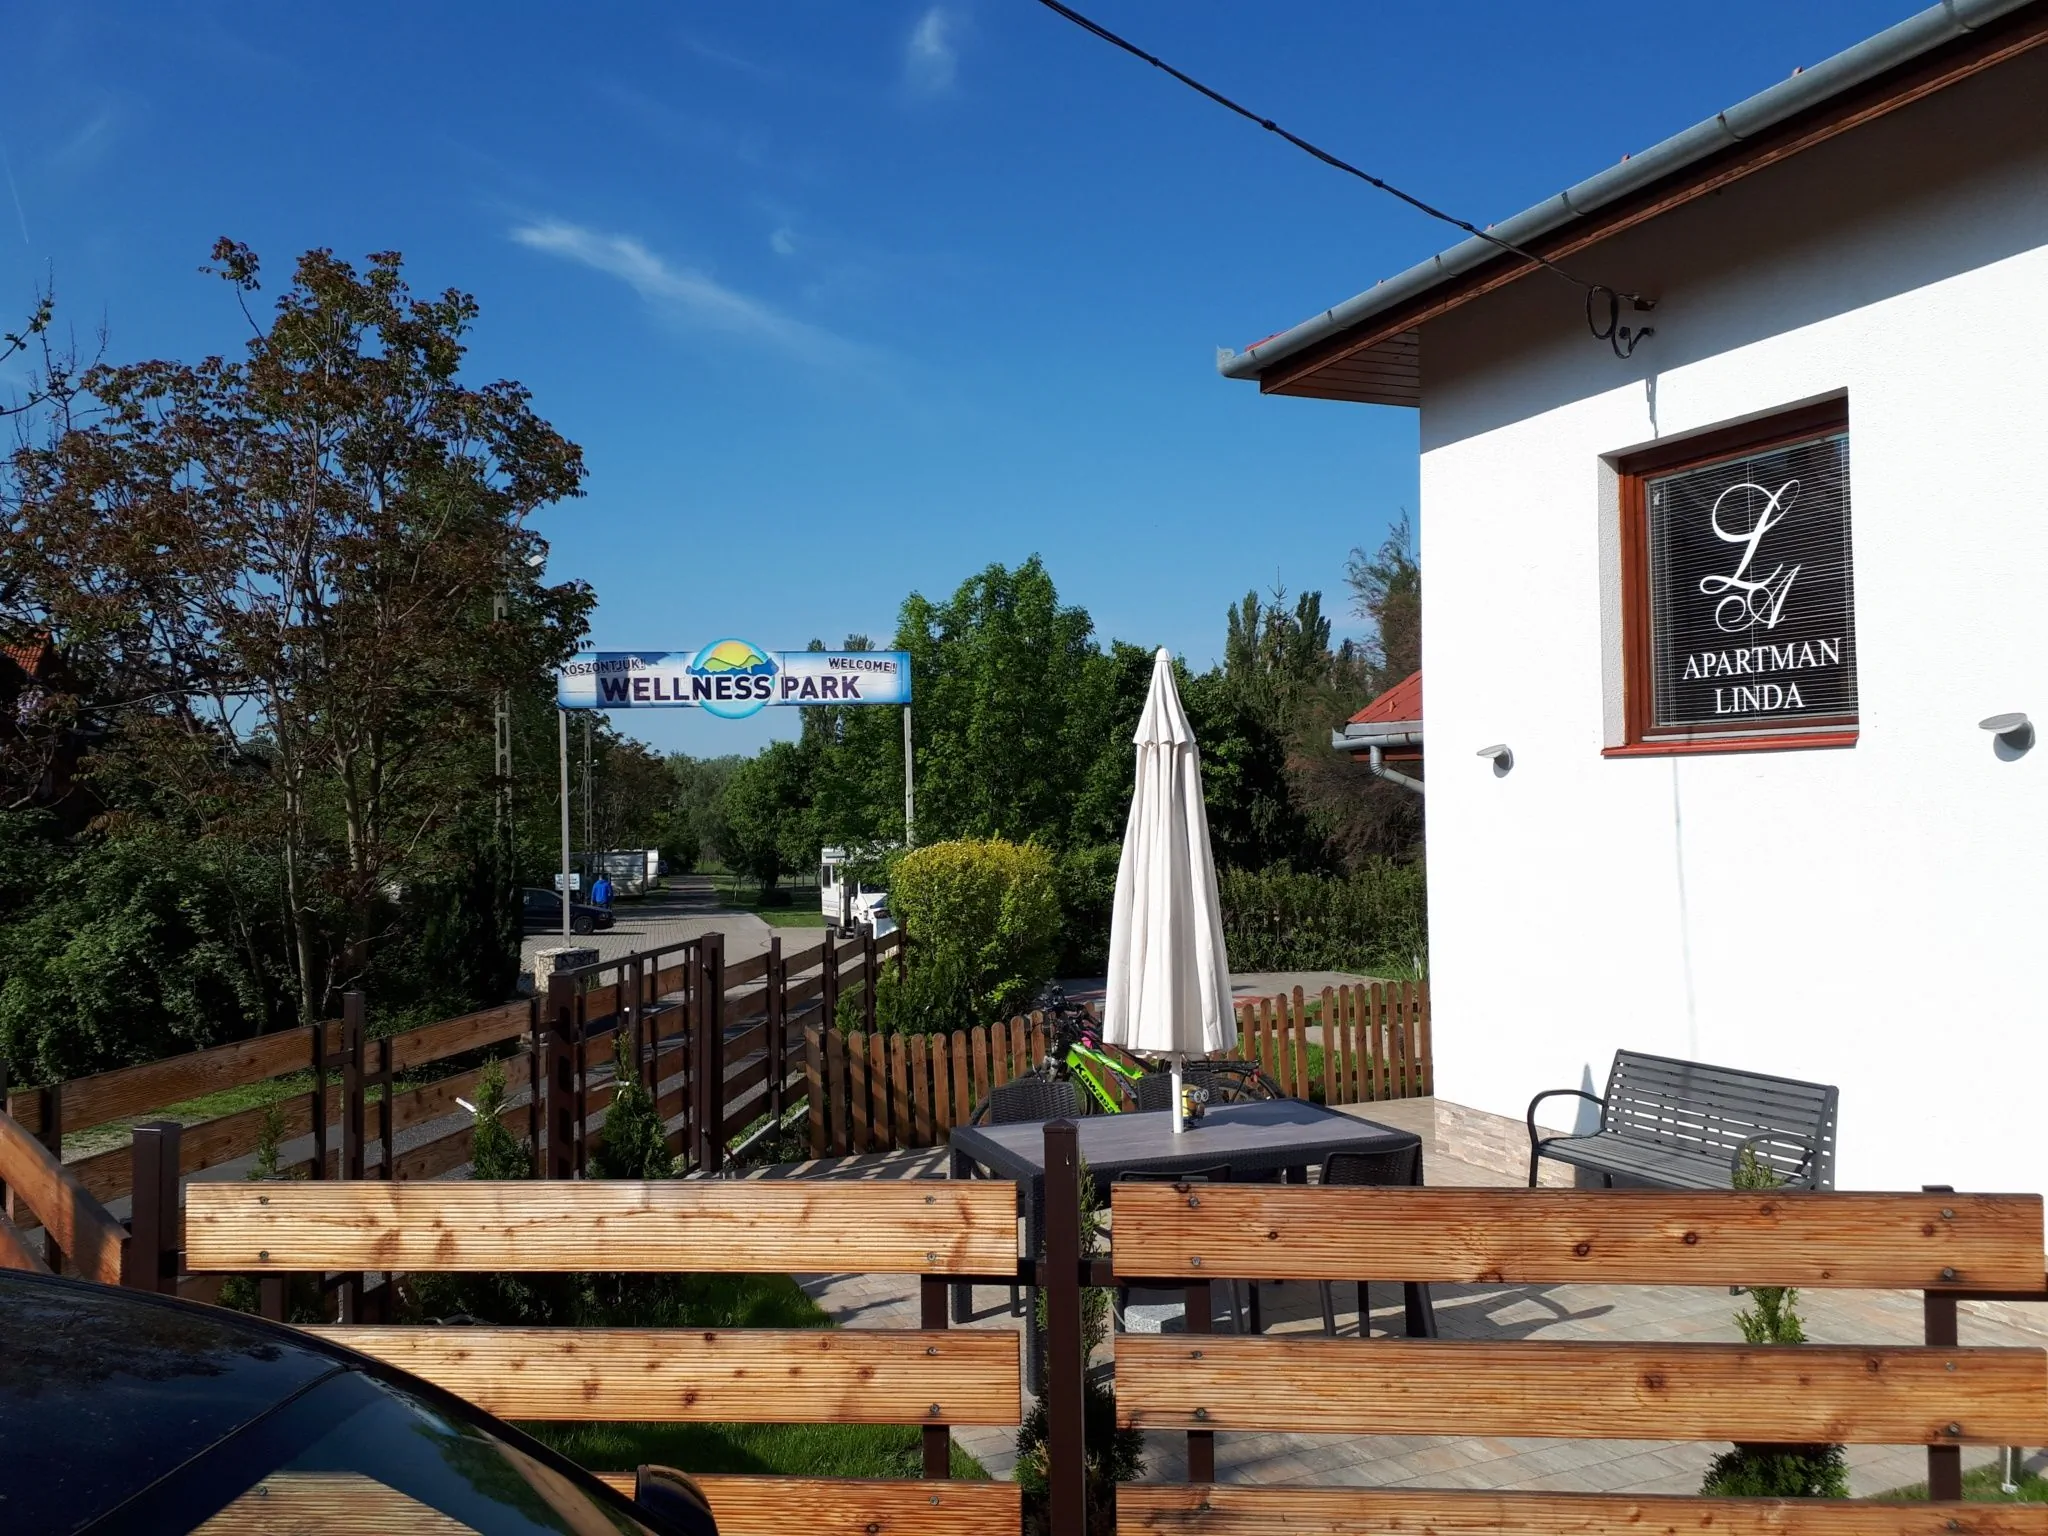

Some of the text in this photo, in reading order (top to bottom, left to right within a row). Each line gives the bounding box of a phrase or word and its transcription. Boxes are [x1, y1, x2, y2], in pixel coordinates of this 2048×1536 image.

[828, 657, 897, 673] WELCOME!
[1682, 637, 1842, 680] APARTMAN
[601, 675, 862, 701] WELLNESS PARK
[1715, 682, 1806, 713] LINDA
[1074, 1062, 1116, 1114] Kawasa
